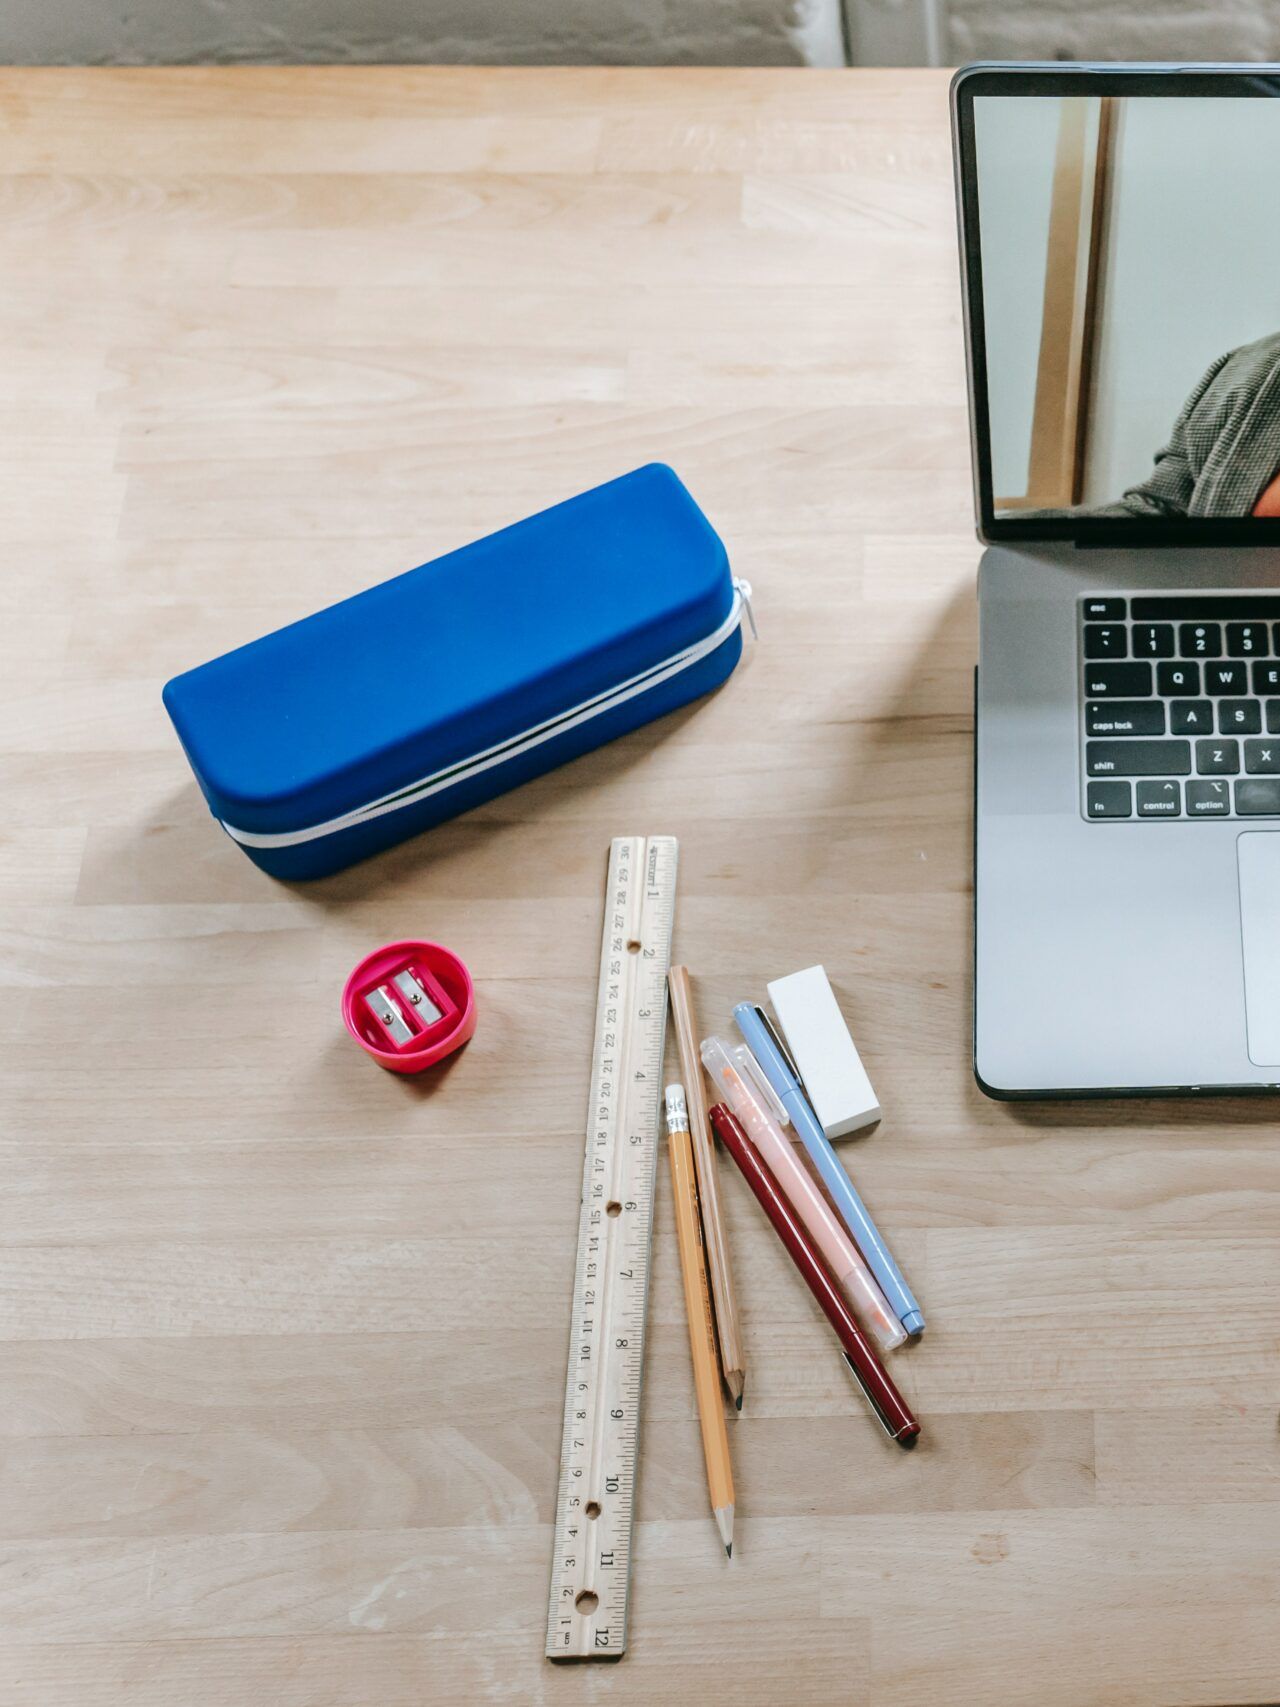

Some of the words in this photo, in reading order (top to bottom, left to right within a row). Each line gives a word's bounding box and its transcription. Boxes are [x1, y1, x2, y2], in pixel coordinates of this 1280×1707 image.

[1148, 639, 1157, 652] 1
[1195, 638, 1206, 651] 2
[1242, 638, 1253, 651] 3
[1091, 682, 1107, 692] tab
[1172, 671, 1185, 685] Q
[1218, 671, 1234, 684] W
[1268, 670, 1279, 683] E
[1186, 710, 1198, 723] A
[1234, 709, 1246, 723] S
[1093, 761, 1115, 771] shift
[1212, 750, 1224, 763] Z
[1260, 749, 1272, 762] X
[1143, 801, 1175, 810] control
[1195, 800, 1224, 811] option
[620, 846, 630, 860] 30
[618, 868, 629, 883] 29
[616, 890, 627, 905] 28
[614, 914, 625, 929] 27
[612, 937, 623, 952] 26
[642, 948, 656, 957] 2
[610, 961, 621, 976] 25
[608, 984, 619, 1000] 24
[606, 1009, 617, 1024] 23
[638, 1009, 651, 1018] 3
[604, 1033, 615, 1049] 22
[602, 1059, 613, 1073] 21
[633, 1071, 646, 1080] 4
[600, 1083, 611, 1098] 20
[599, 1106, 609, 1122] 19
[597, 1131, 607, 1147] 18
[629, 1136, 642, 1145] 5
[595, 1158, 605, 1173] 17
[593, 1184, 603, 1199] 16
[624, 1201, 637, 1211] 6
[590, 1210, 601, 1226] 15
[588, 1237, 599, 1253] 14
[587, 1263, 597, 1278] 13
[619, 1269, 633, 1278] 7
[585, 1290, 596, 1306] 12
[583, 1319, 593, 1333] 11
[615, 1338, 629, 1348] 8
[581, 1345, 591, 1361] 10
[578, 1383, 588, 1391] 9
[576, 1411, 586, 1420] 8
[610, 1409, 624, 1419] 9
[574, 1440, 584, 1448] 7
[572, 1469, 582, 1478] 6
[605, 1476, 619, 1492] 10
[570, 1498, 580, 1507] 5
[568, 1528, 578, 1538] 4
[566, 1559, 576, 1567] 3
[601, 1551, 614, 1567] 11
[564, 1588, 574, 1597] 2
[564, 1631, 571, 1645] cm
[594, 1628, 609, 1646] 12
